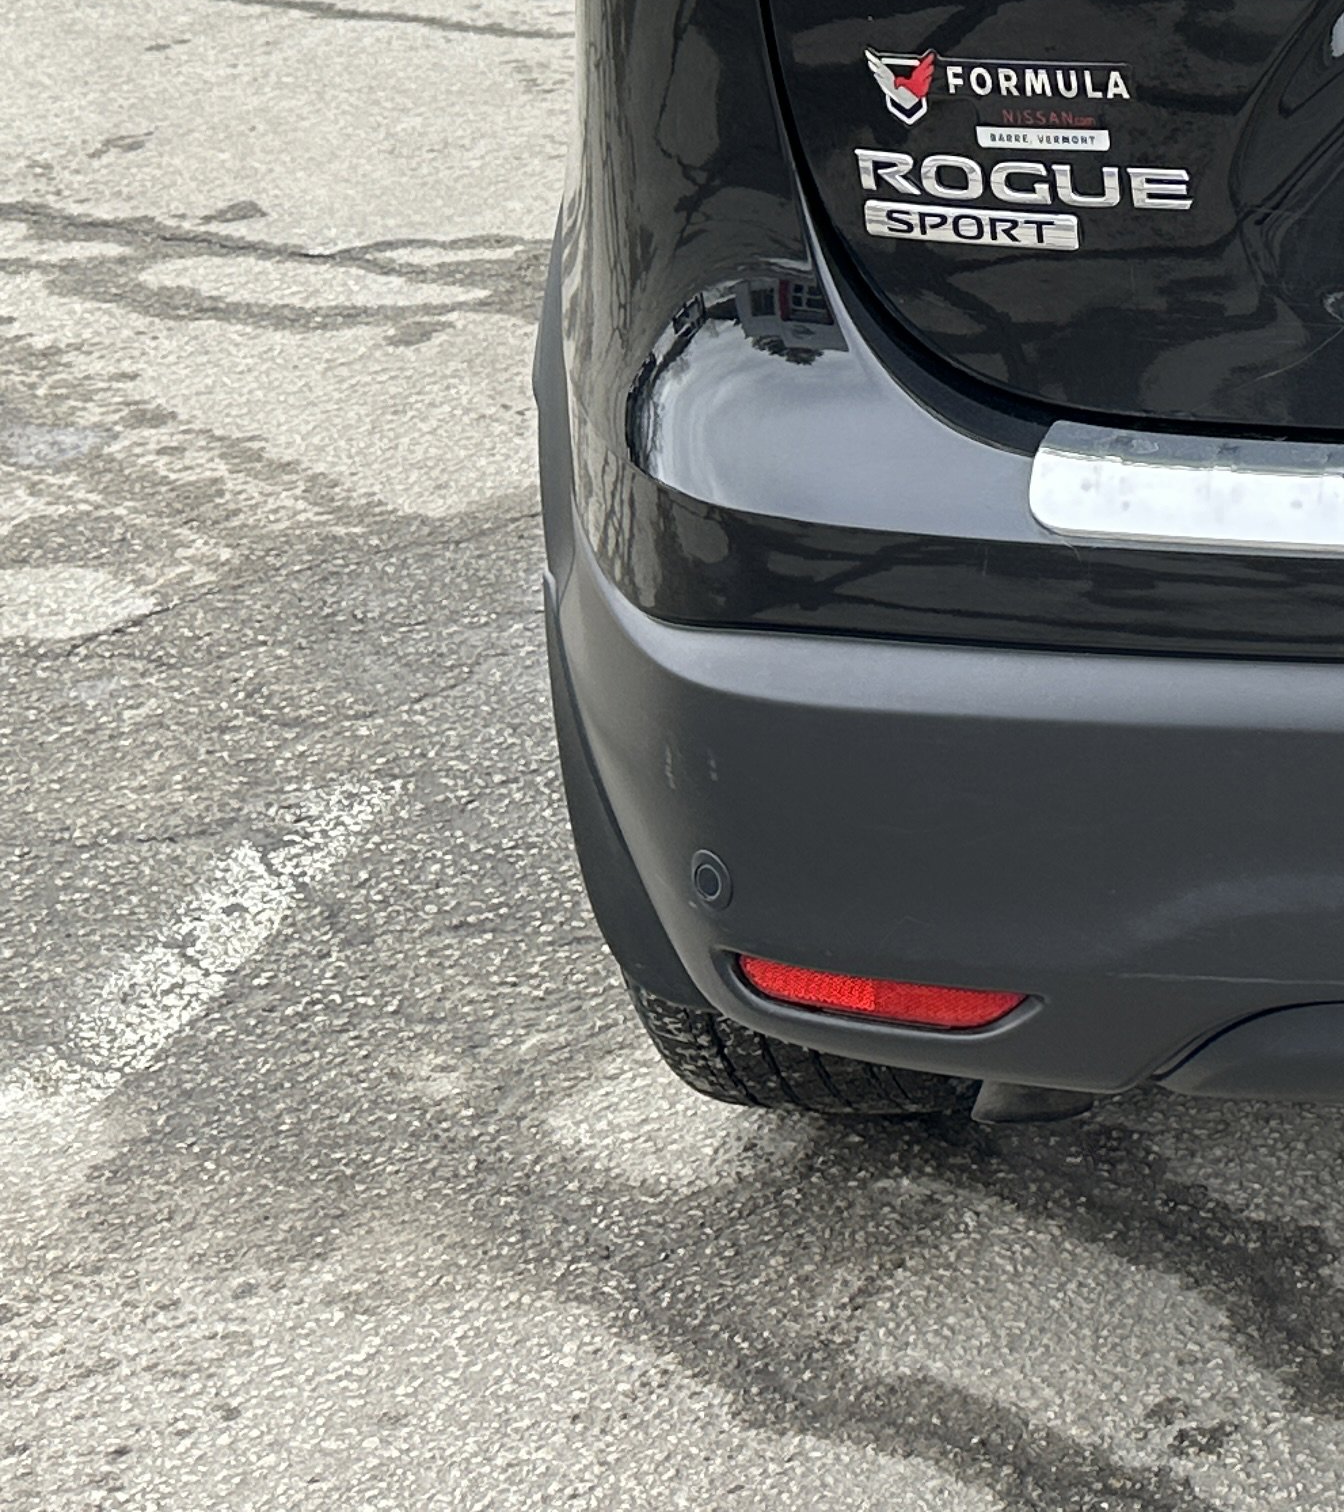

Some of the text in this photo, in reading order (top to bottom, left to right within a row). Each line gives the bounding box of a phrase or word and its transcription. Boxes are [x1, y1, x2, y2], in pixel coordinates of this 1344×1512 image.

[947, 66, 1130, 99] FORMULA
[1037, 134, 1096, 146] VERMONT
[854, 148, 1194, 209] ROGUE
[886, 210, 1056, 243] SPORT
